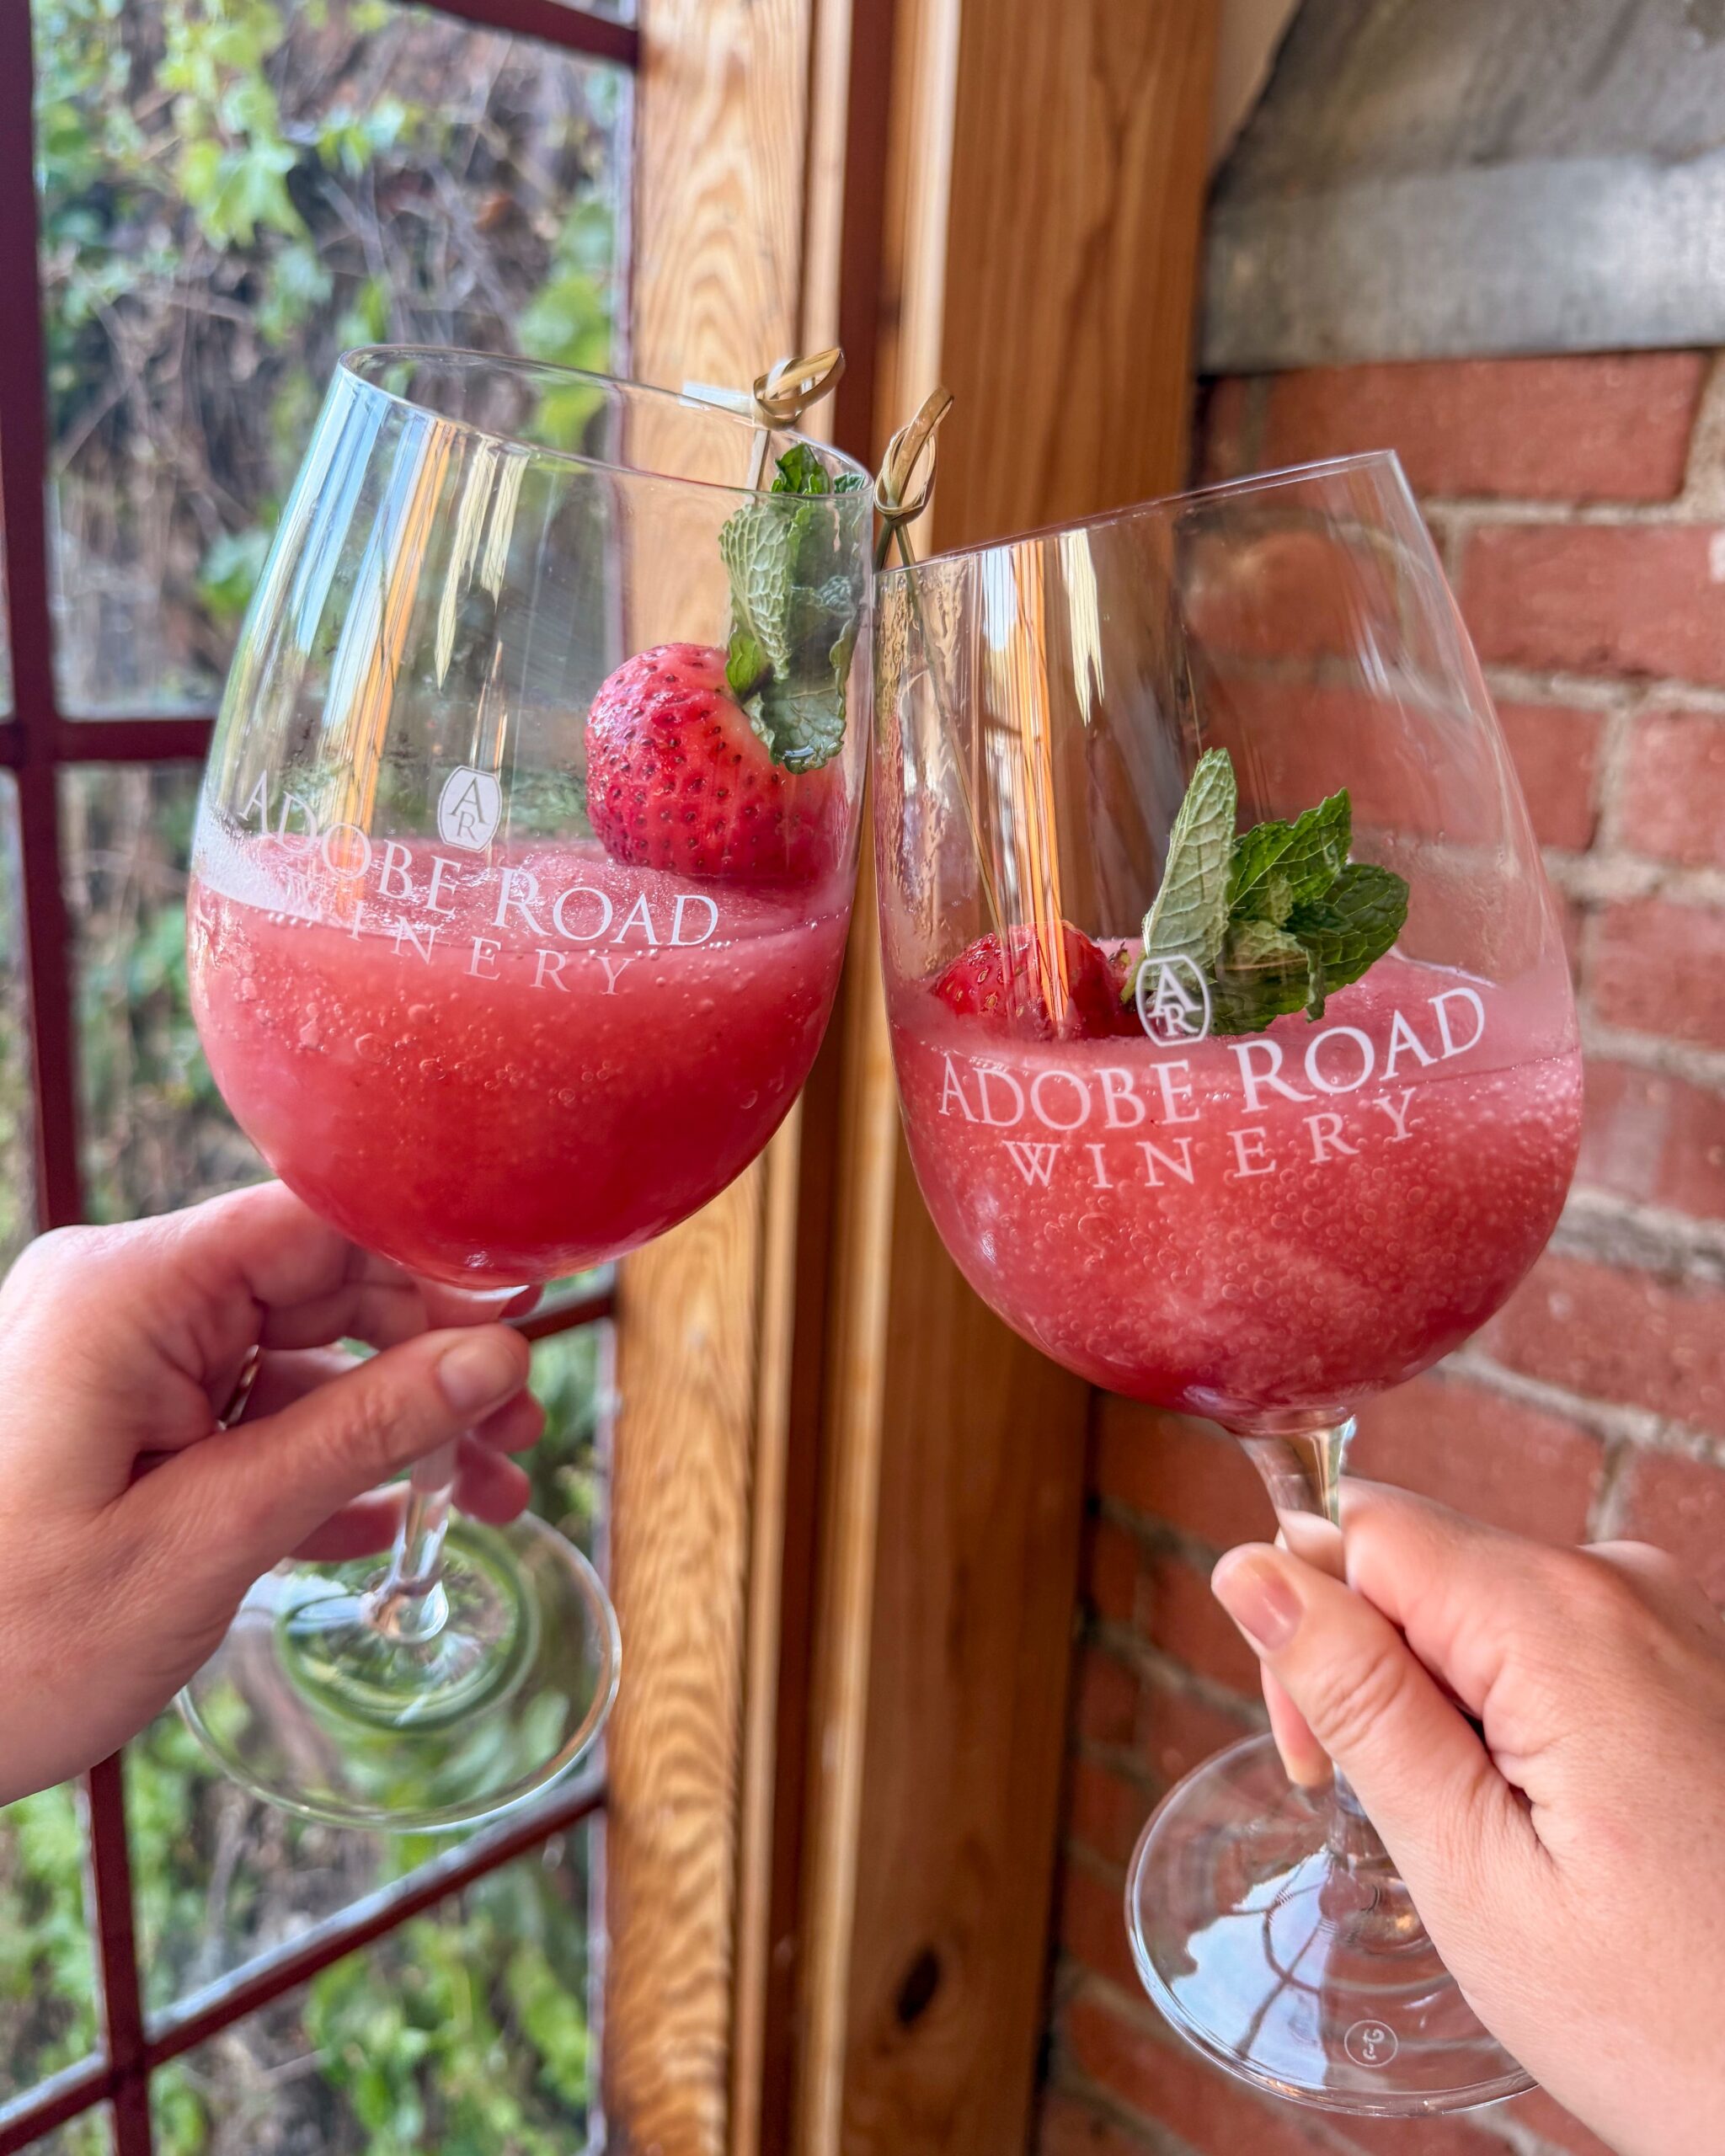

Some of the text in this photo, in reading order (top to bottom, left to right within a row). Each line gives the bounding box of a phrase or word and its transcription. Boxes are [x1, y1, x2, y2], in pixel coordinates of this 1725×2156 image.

[238, 770, 720, 947] ADOBE ROAD
[937, 986, 1485, 1130] ADOBE ROAD
[1001, 1086, 1418, 1190] WINERY
